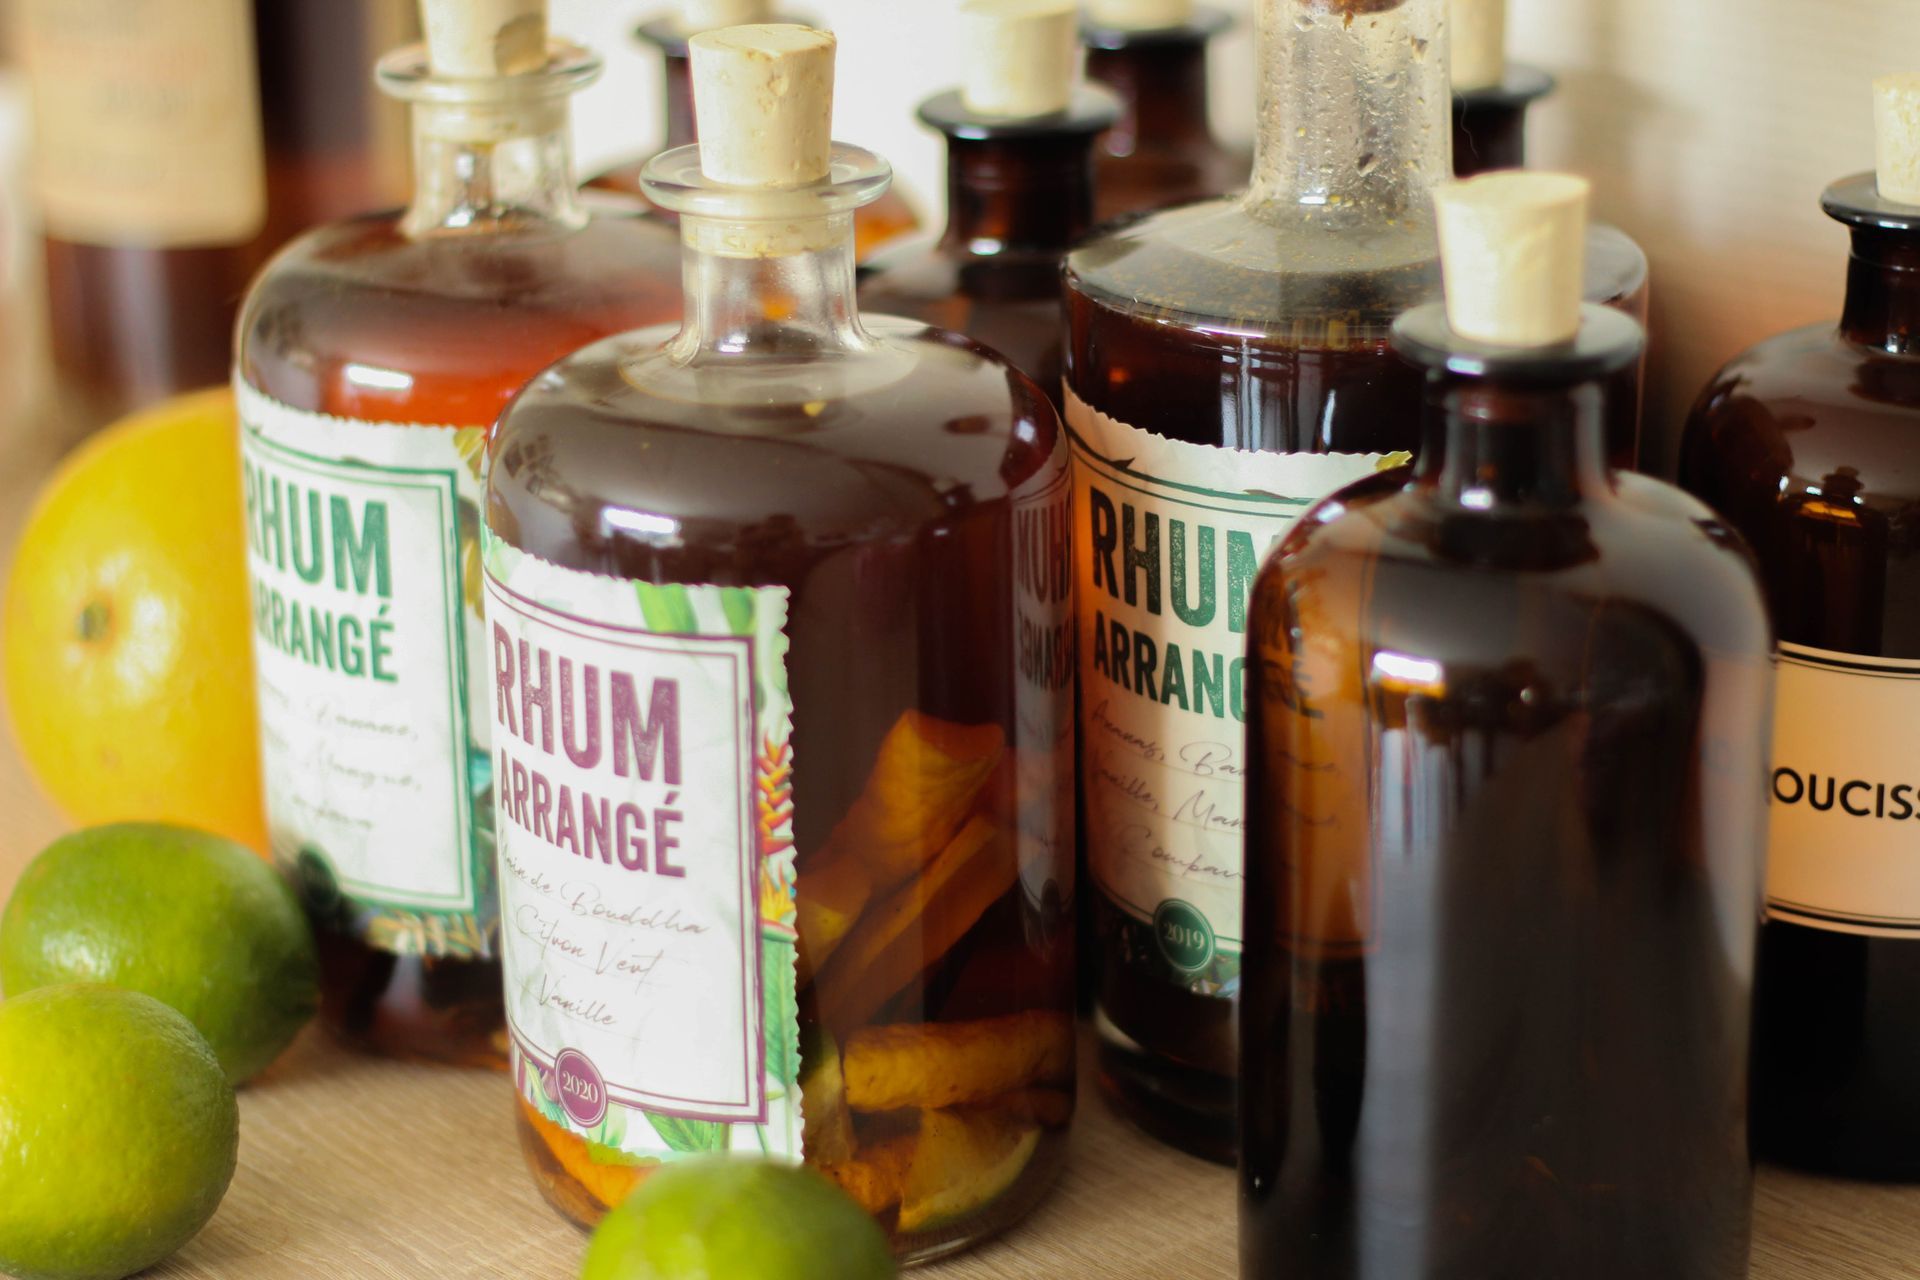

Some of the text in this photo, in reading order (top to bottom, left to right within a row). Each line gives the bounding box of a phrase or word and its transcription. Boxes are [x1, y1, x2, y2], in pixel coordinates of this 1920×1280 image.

[255, 579, 397, 683] RRANGÉ
[494, 619, 682, 785] RHUM
[501, 747, 686, 878] ARRANGÉ
[1773, 766, 1920, 820] OUCIS
[530, 872, 553, 893] de
[1164, 921, 1205, 949] 2019
[539, 973, 617, 1025] Vanille
[561, 1071, 599, 1104] 2020
